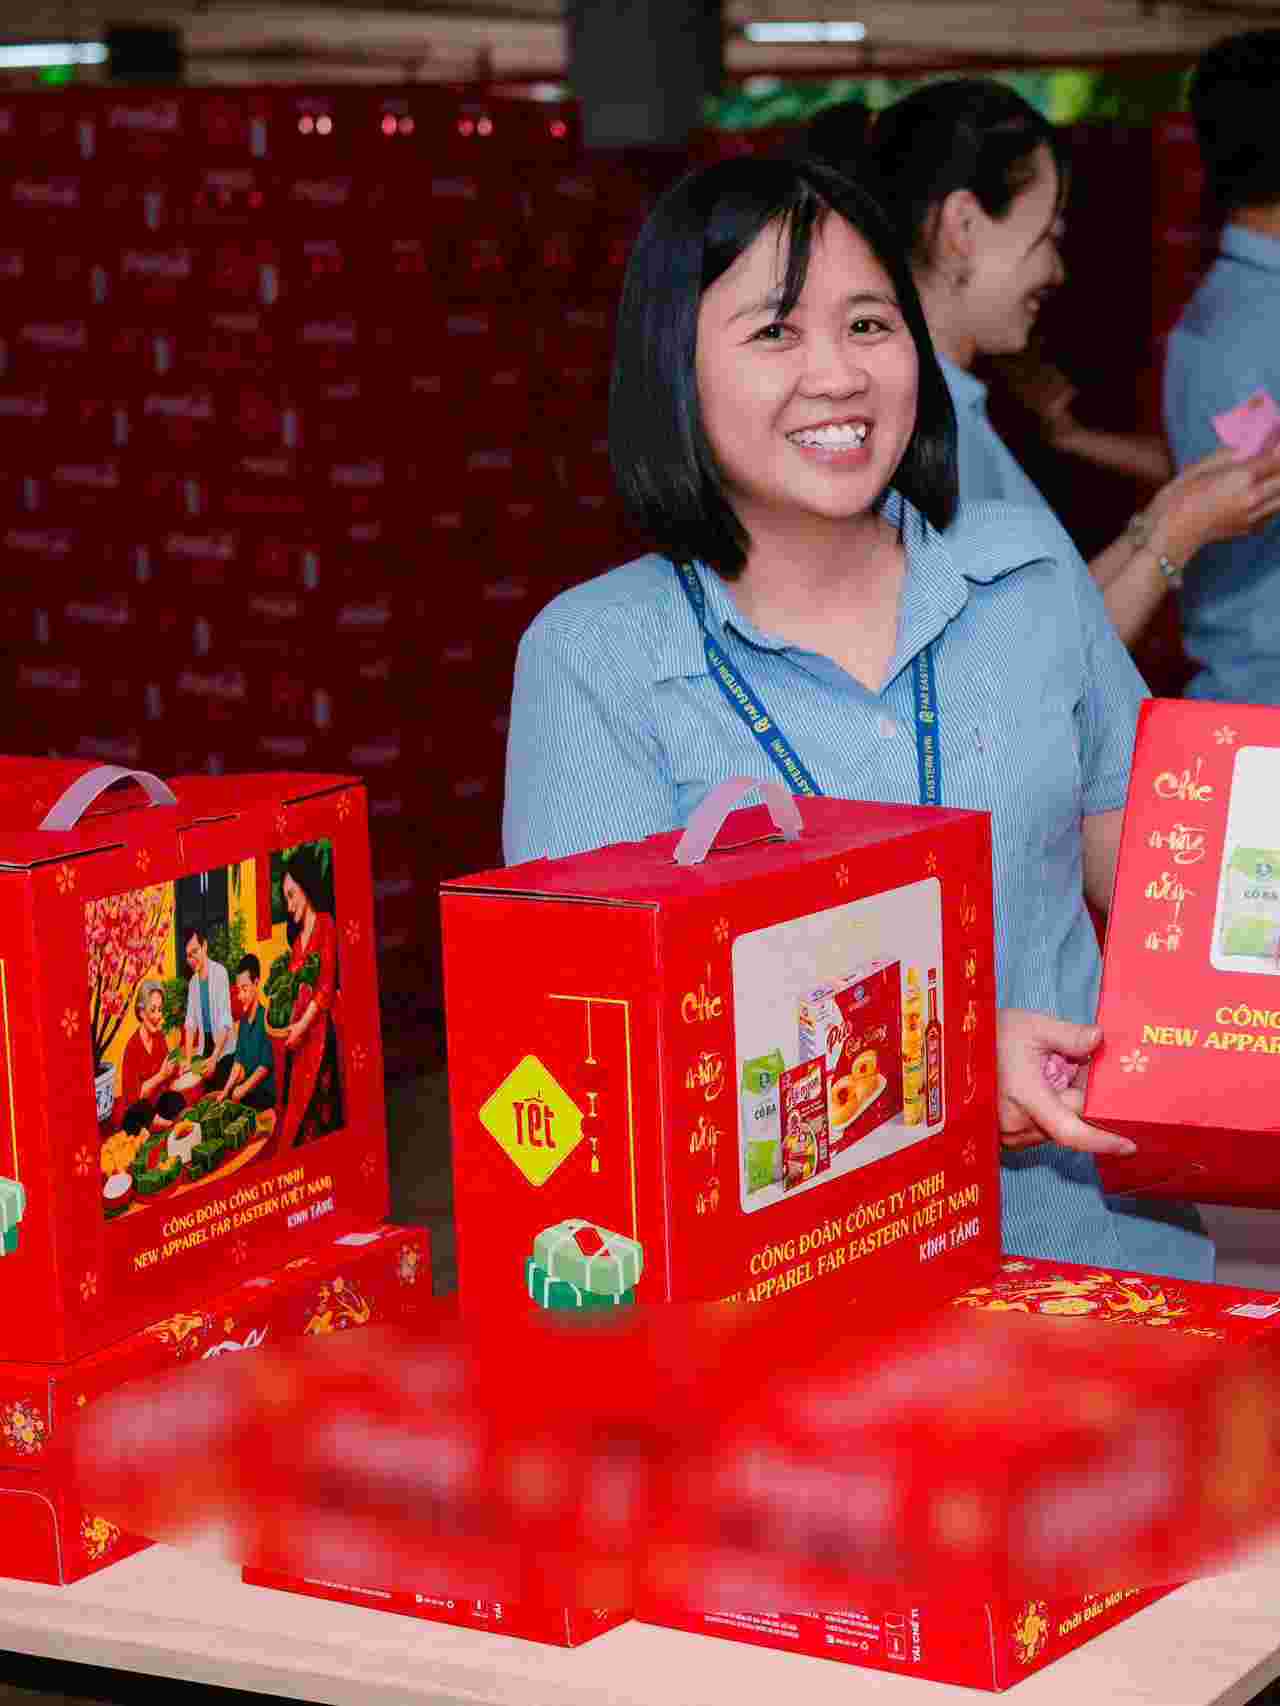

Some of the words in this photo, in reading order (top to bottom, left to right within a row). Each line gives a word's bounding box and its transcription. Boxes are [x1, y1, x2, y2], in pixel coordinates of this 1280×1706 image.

[1141, 1024, 1199, 1048] NEW
[511, 1087, 557, 1149] Tết
[163, 1210, 195, 1237] CÔNG
[745, 1261, 816, 1304] APPAREL
[817, 1247, 846, 1277] FAR
[847, 1216, 910, 1261] EASTERN
[947, 1183, 980, 1214] NAM)
[750, 1241, 796, 1275] CÔNG
[798, 1217, 842, 1256] ĐOÀN
[846, 1199, 886, 1234] CÔNG
[887, 1189, 907, 1217] TY
[908, 1170, 945, 1206] TNHH
[133, 1248, 160, 1273] NEW
[160, 1229, 209, 1260] APPAREL
